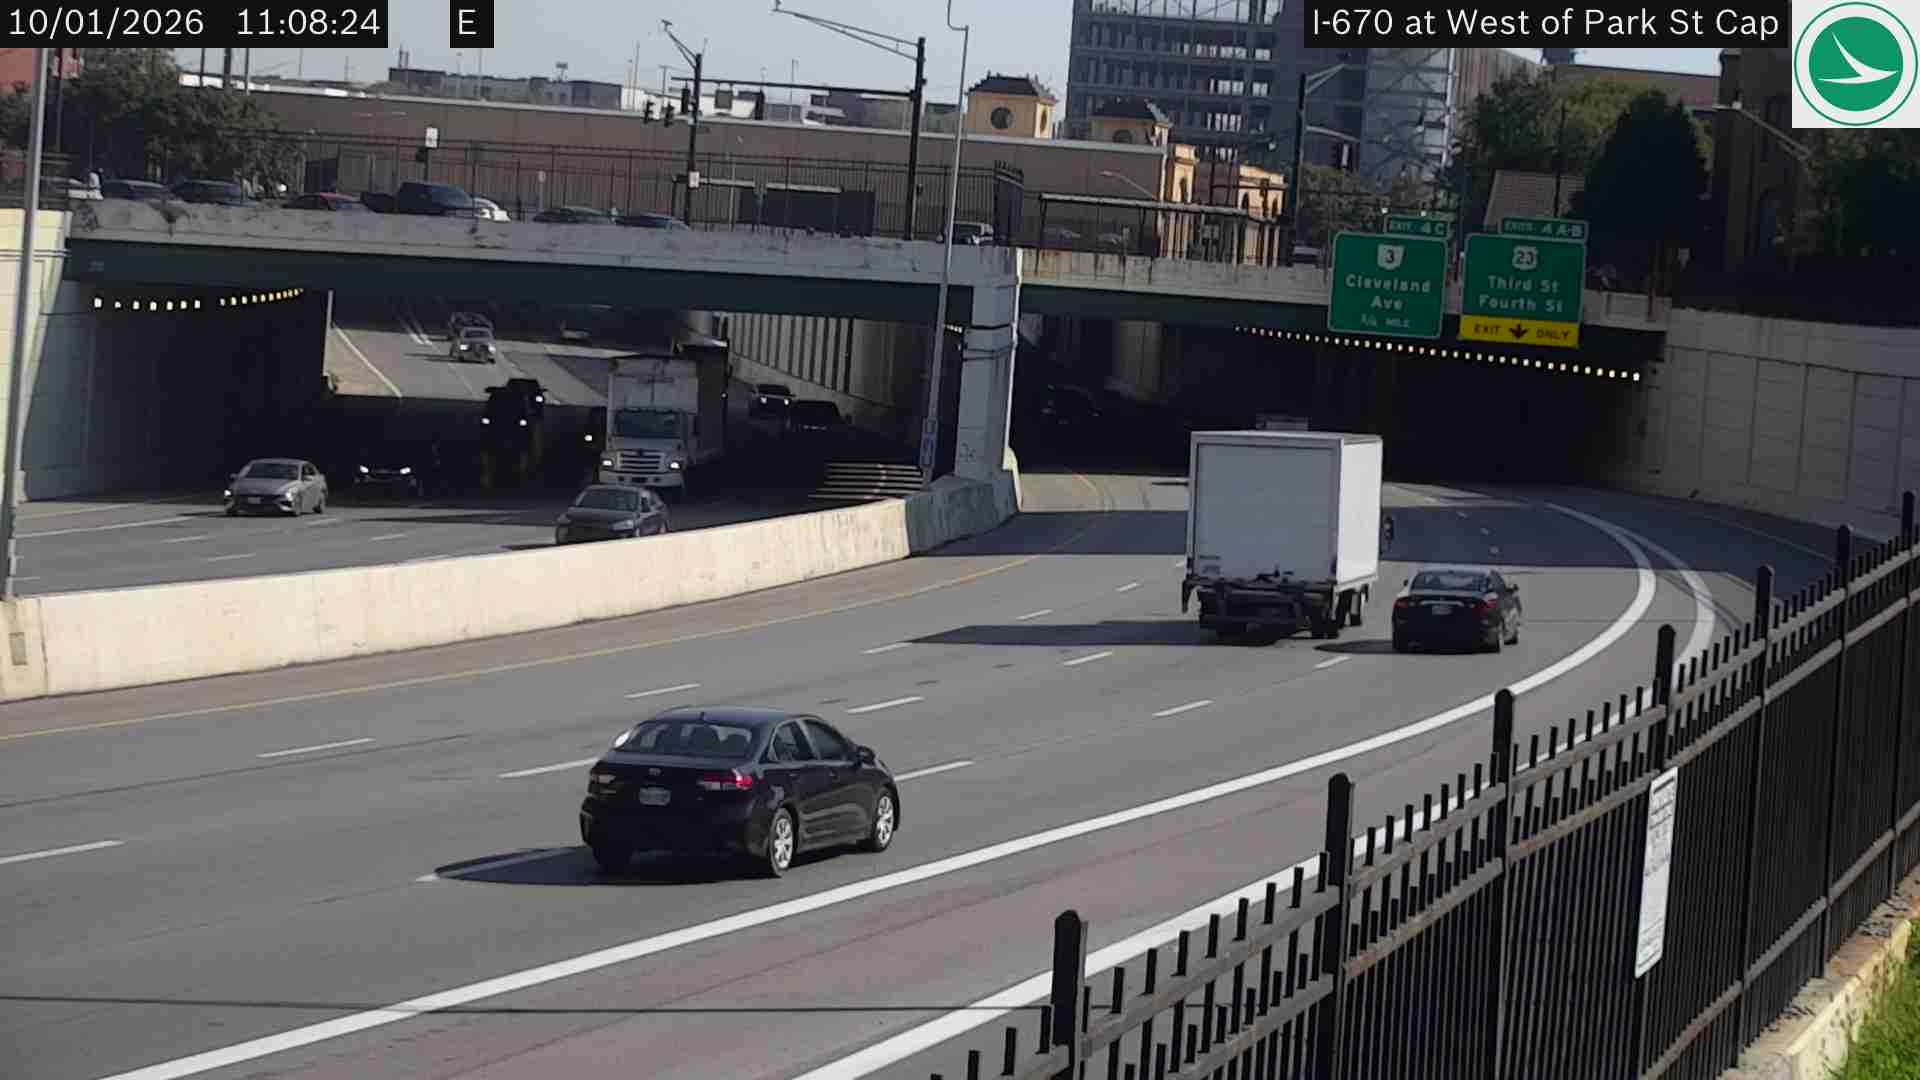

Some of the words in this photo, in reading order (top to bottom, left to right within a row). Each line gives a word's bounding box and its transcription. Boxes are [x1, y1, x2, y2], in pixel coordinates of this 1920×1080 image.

[1385, 249, 1395, 263] 3
[1345, 273, 1431, 293] Cleveland
[1487, 275, 1533, 292] Third
[1540, 279, 1559, 294] St
[1370, 295, 1403, 311] Ave
[1479, 294, 1537, 312] Fourth
[1544, 299, 1562, 313] St
[1473, 323, 1501, 336] EXIT
[1536, 329, 1569, 341] ONLY
